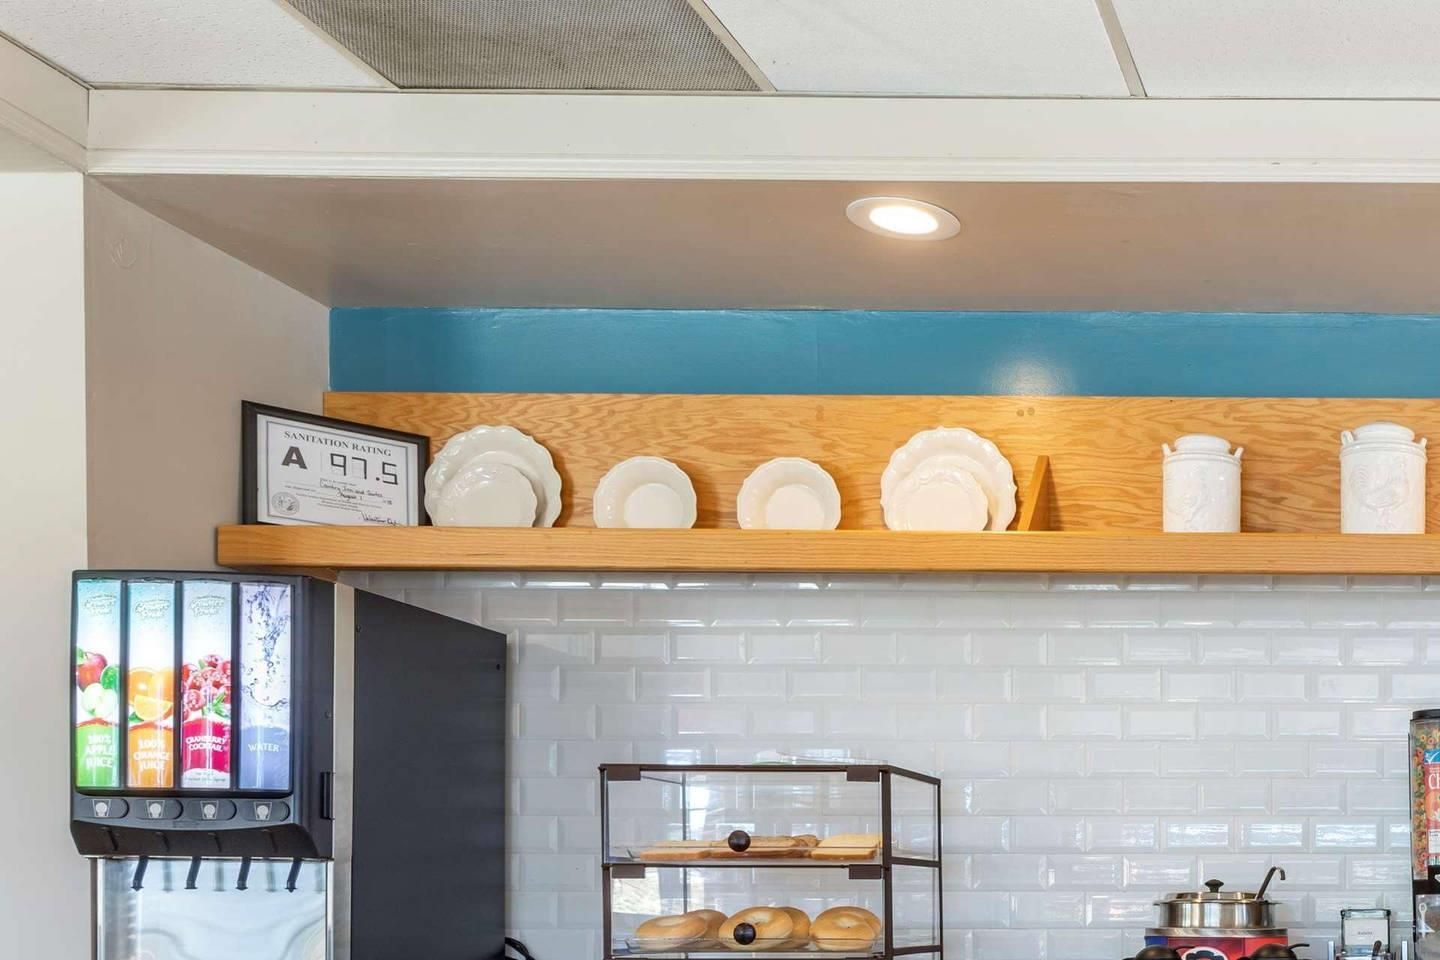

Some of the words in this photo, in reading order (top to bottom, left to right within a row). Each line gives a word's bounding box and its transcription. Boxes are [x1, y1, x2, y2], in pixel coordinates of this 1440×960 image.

[284, 431, 349, 449] SANITATION
[352, 442, 392, 457] RATING
[281, 446, 308, 470] A
[330, 452, 398, 485] 97.5
[186, 735, 227, 744] CRANBERRY
[188, 743, 223, 752] COCKTAIL
[247, 743, 280, 752] WATER
[134, 751, 170, 761] ORANGE
